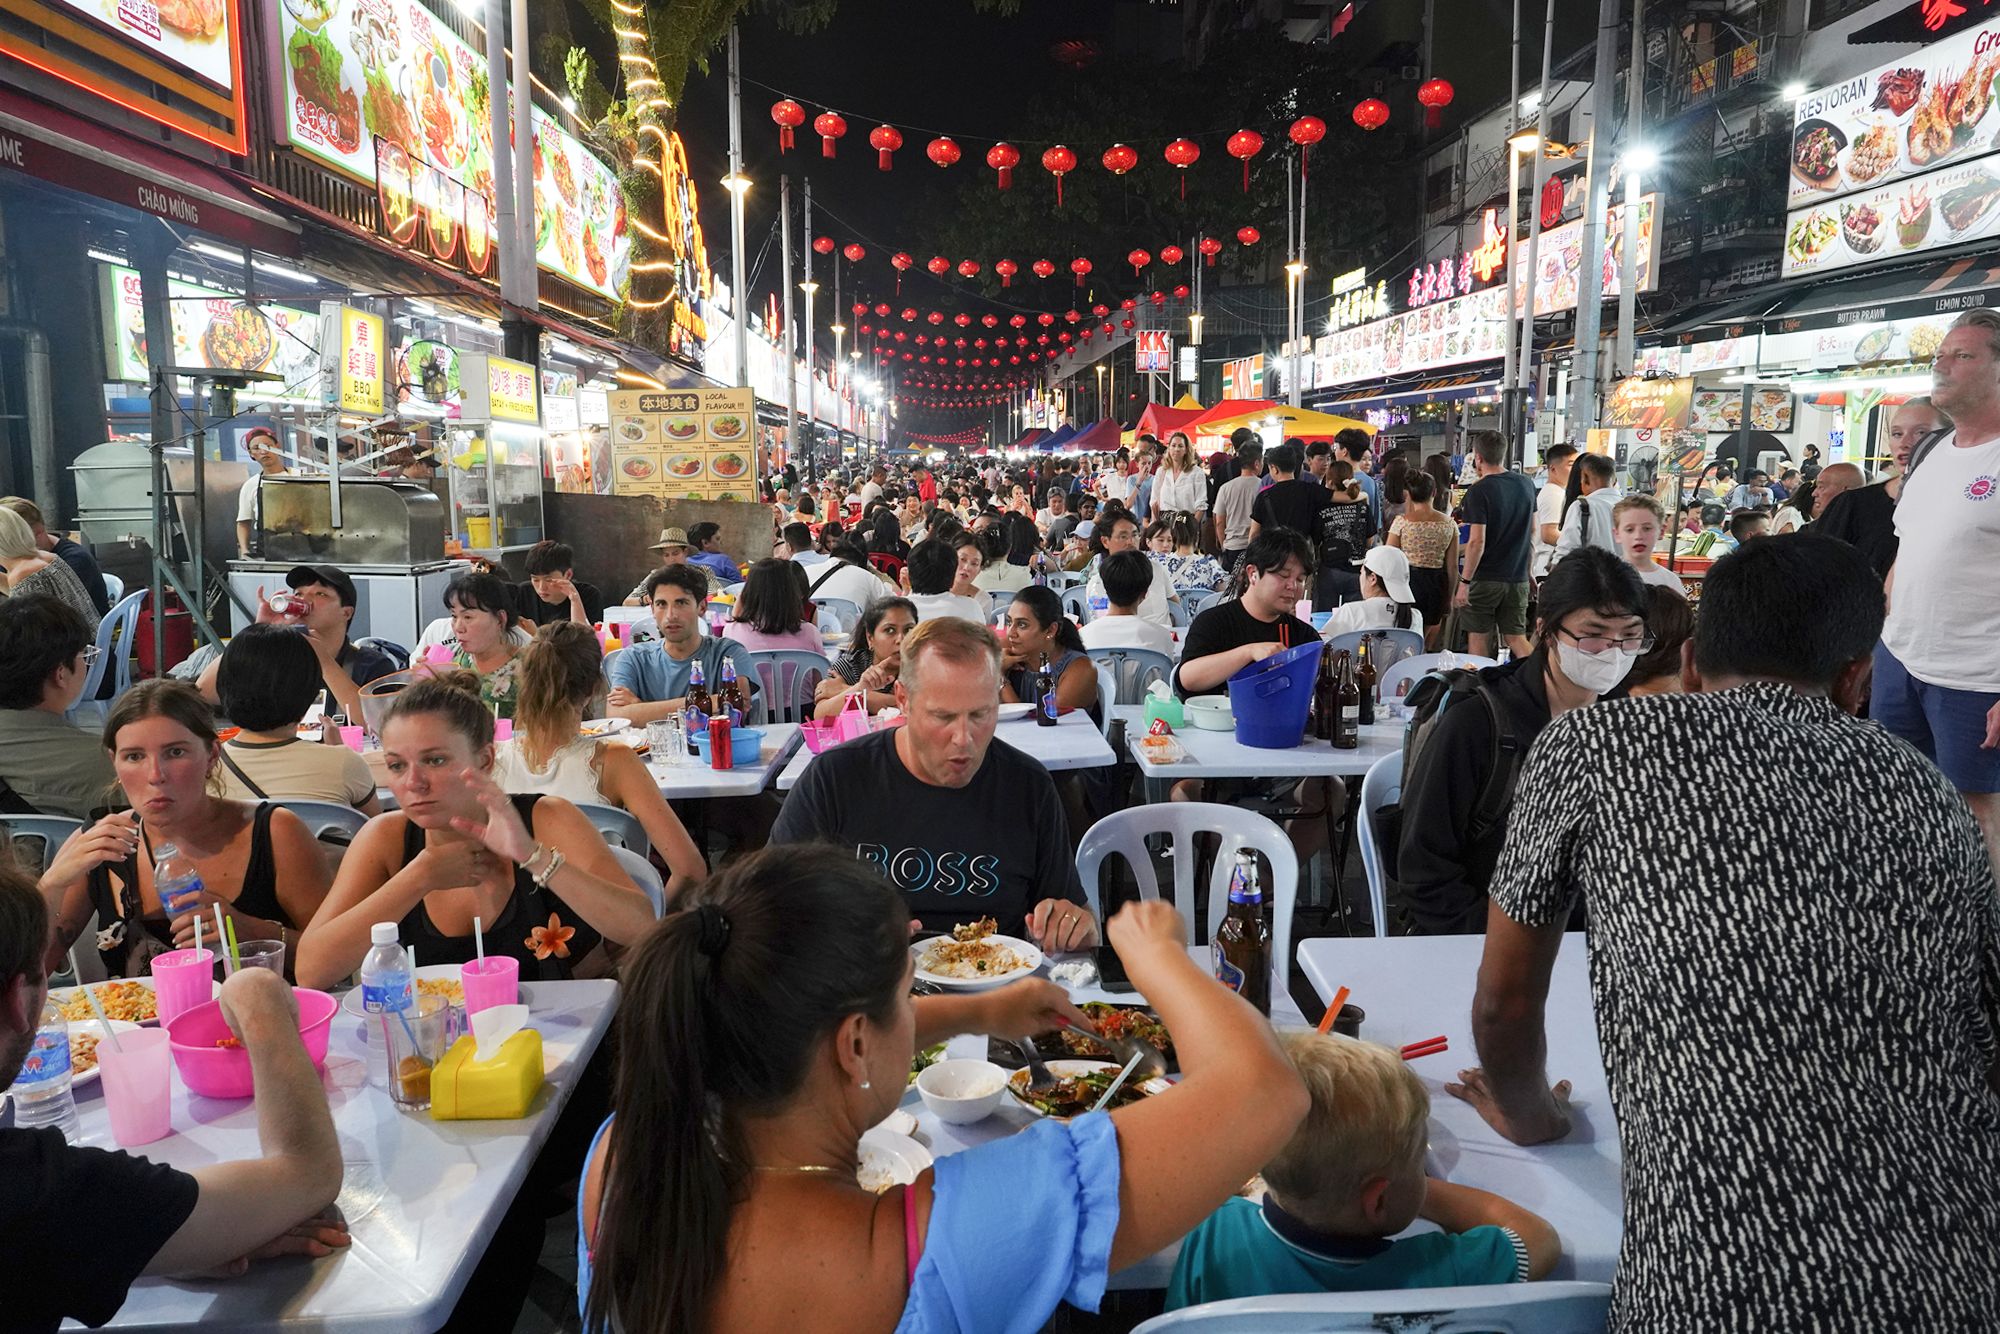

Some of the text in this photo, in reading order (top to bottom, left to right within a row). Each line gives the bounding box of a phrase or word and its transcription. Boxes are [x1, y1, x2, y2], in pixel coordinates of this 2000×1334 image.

[1798, 76, 1868, 121] RESTORAN
[0, 135, 25, 167] ME
[138, 187, 167, 210] CHÀO
[1935, 293, 1985, 311] LEMON SQUID
[1837, 308, 1886, 324] BUTTER PRAWN
[1139, 331, 1167, 351] KK
[1148, 352, 1158, 370] 24
[354, 380, 371, 395] BBQ
[1233, 358, 1254, 399] KK
[344, 393, 380, 408] CHICKEN WING
[641, 396, 697, 410] 本地美食
[705, 402, 736, 410] FLAVOUR
[1150, 720, 1163, 734] F4
